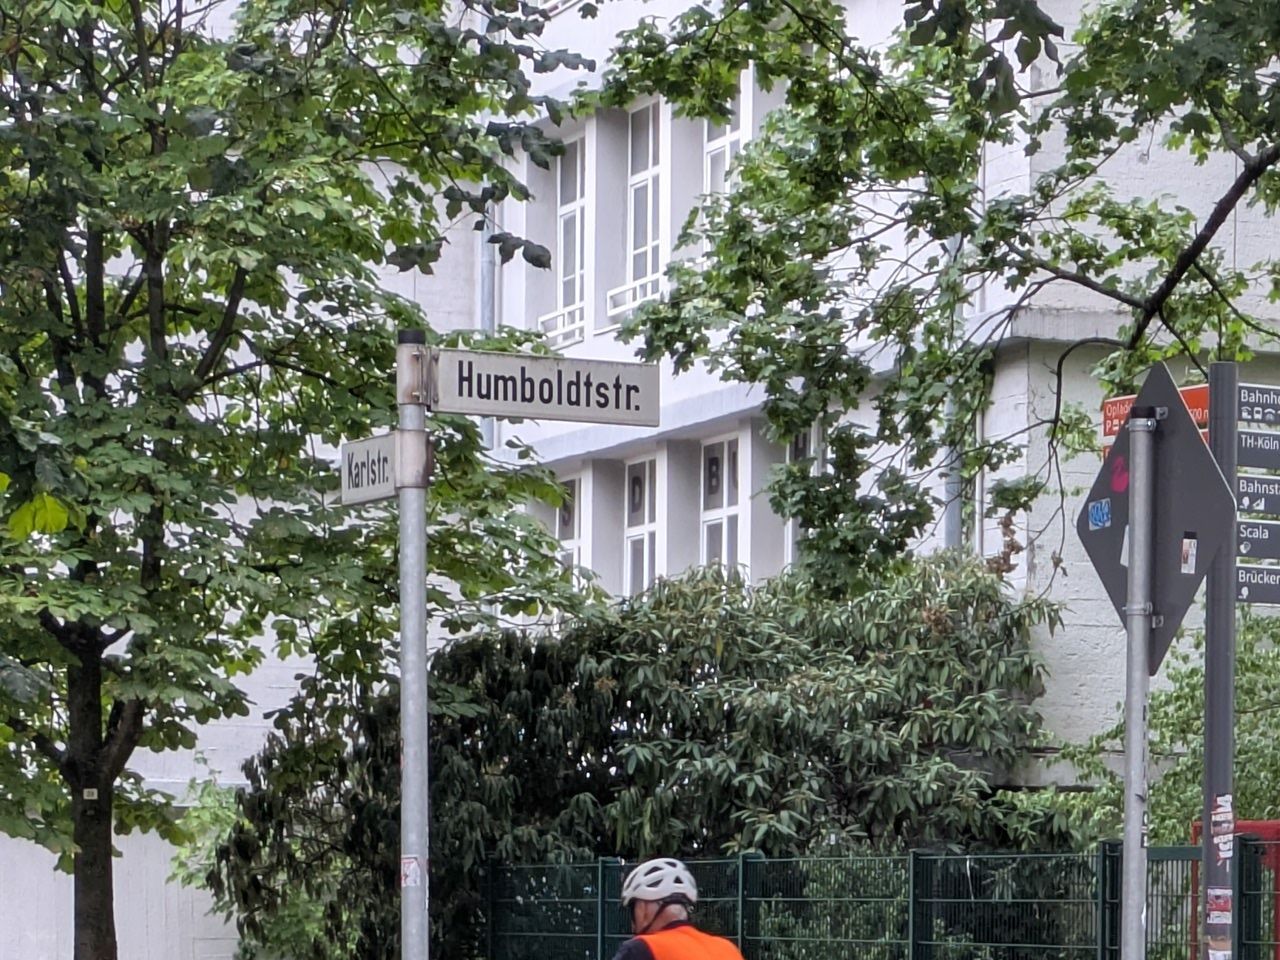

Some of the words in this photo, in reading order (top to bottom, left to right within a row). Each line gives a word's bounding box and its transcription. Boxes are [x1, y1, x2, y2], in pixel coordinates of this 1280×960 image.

[457, 360, 641, 411] Humboldtstr.
[1241, 435, 1279, 450] TH-Köln
[347, 452, 389, 490] Karlstr.
[1240, 525, 1269, 539] Scala
